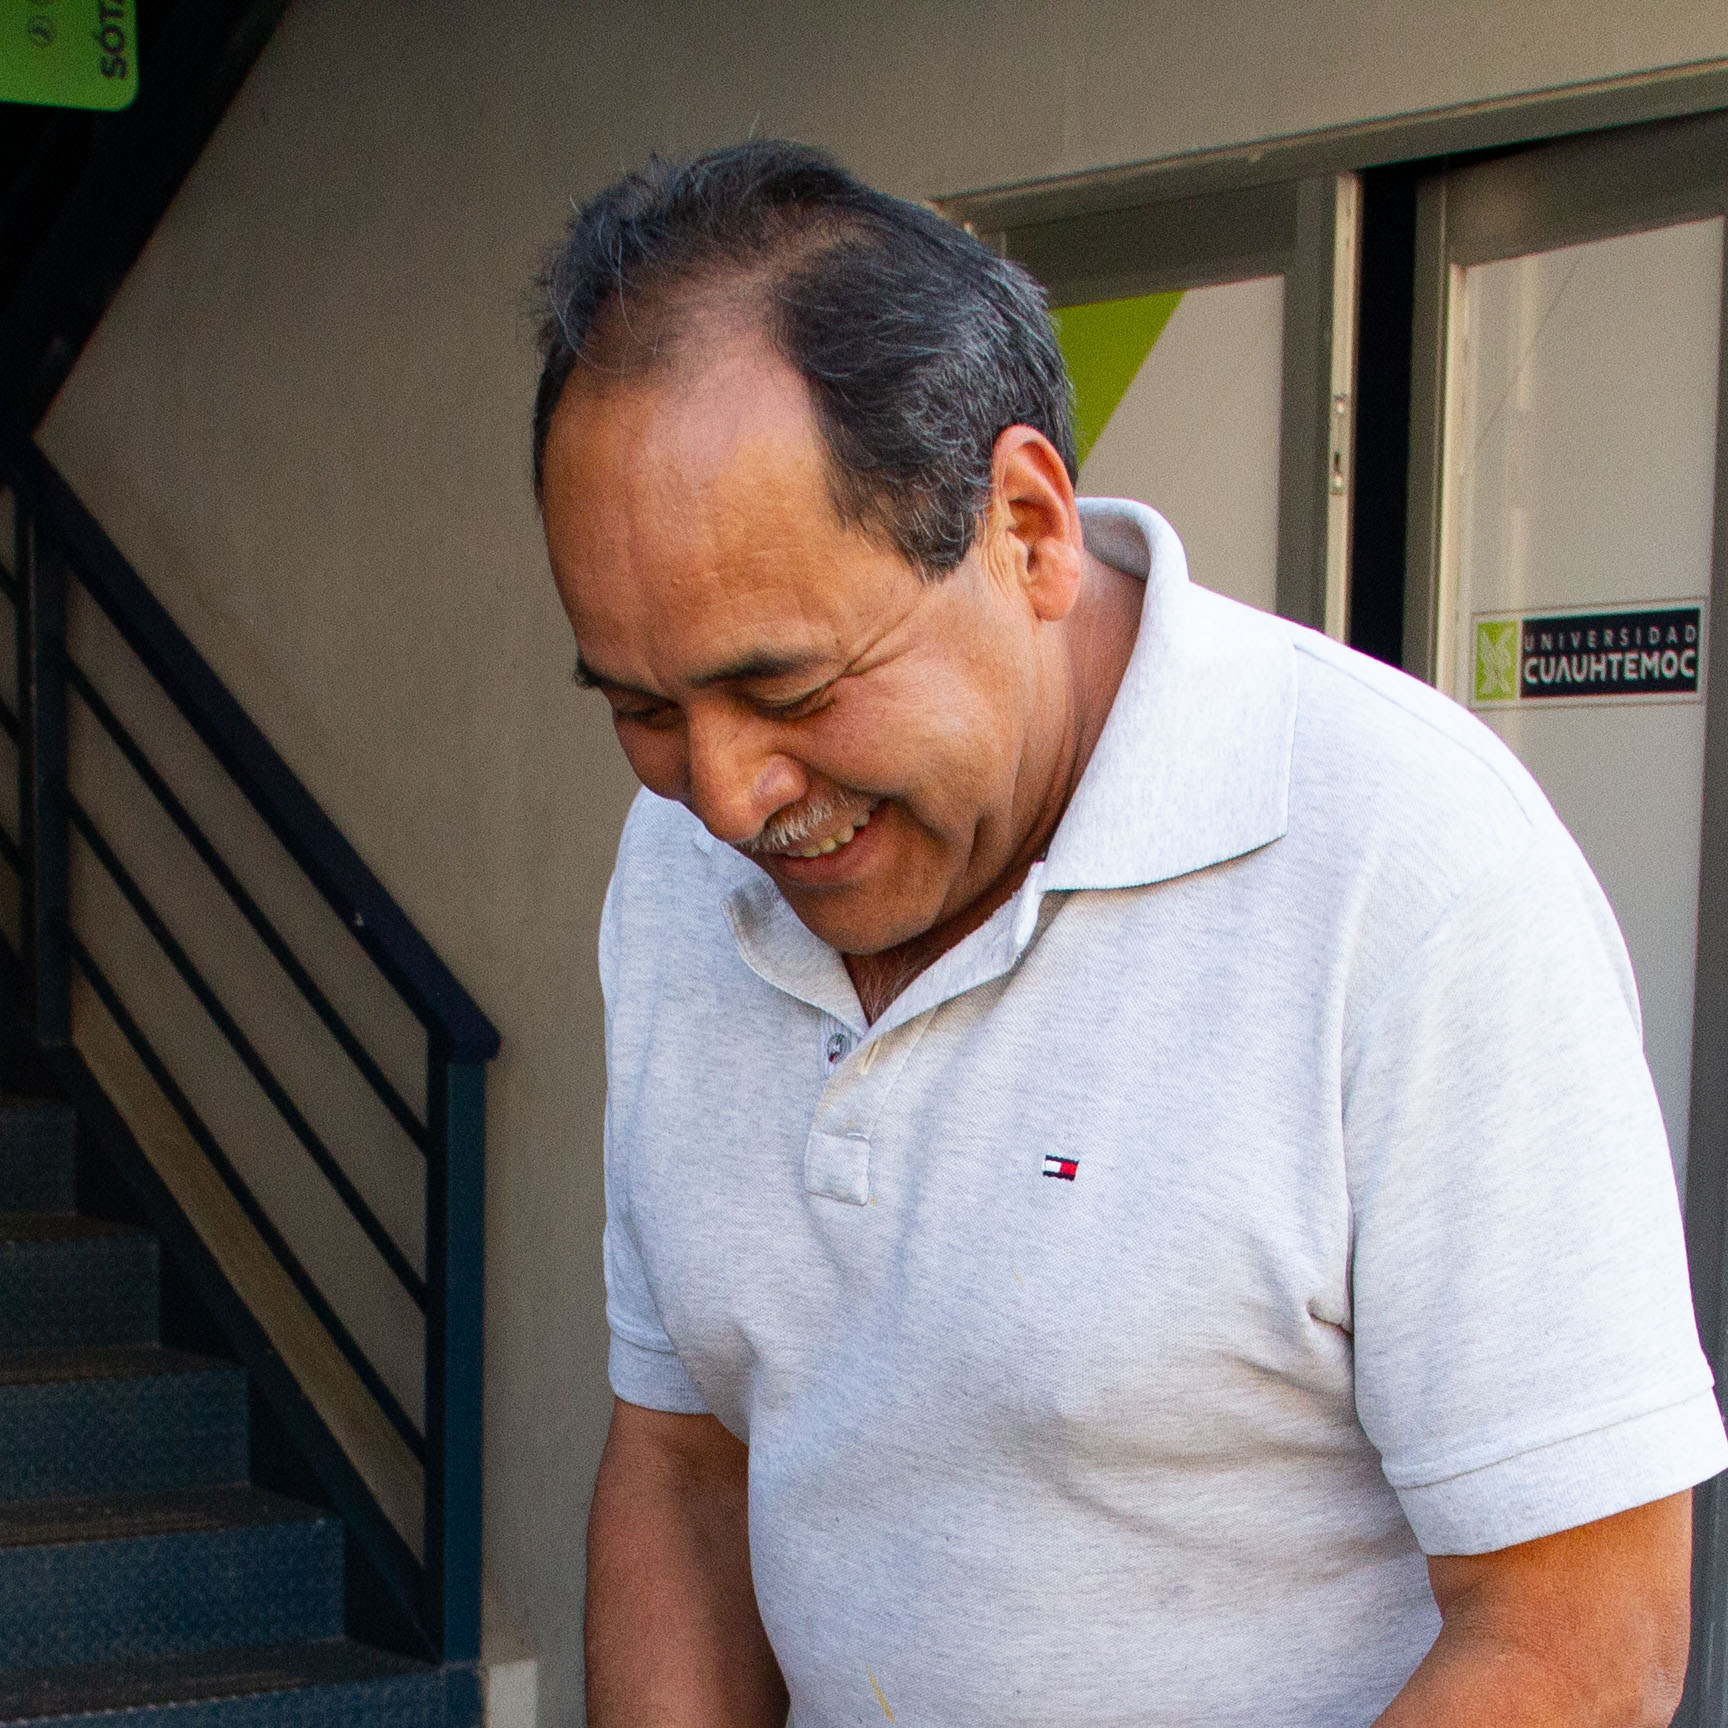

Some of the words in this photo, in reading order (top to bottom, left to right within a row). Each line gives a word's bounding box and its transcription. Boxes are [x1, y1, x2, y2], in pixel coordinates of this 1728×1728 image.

[93, 0, 127, 79] SÓT
[1524, 625, 1696, 650] UNIVERSIDAD
[1524, 650, 1696, 684] CUAUHTEMOC
